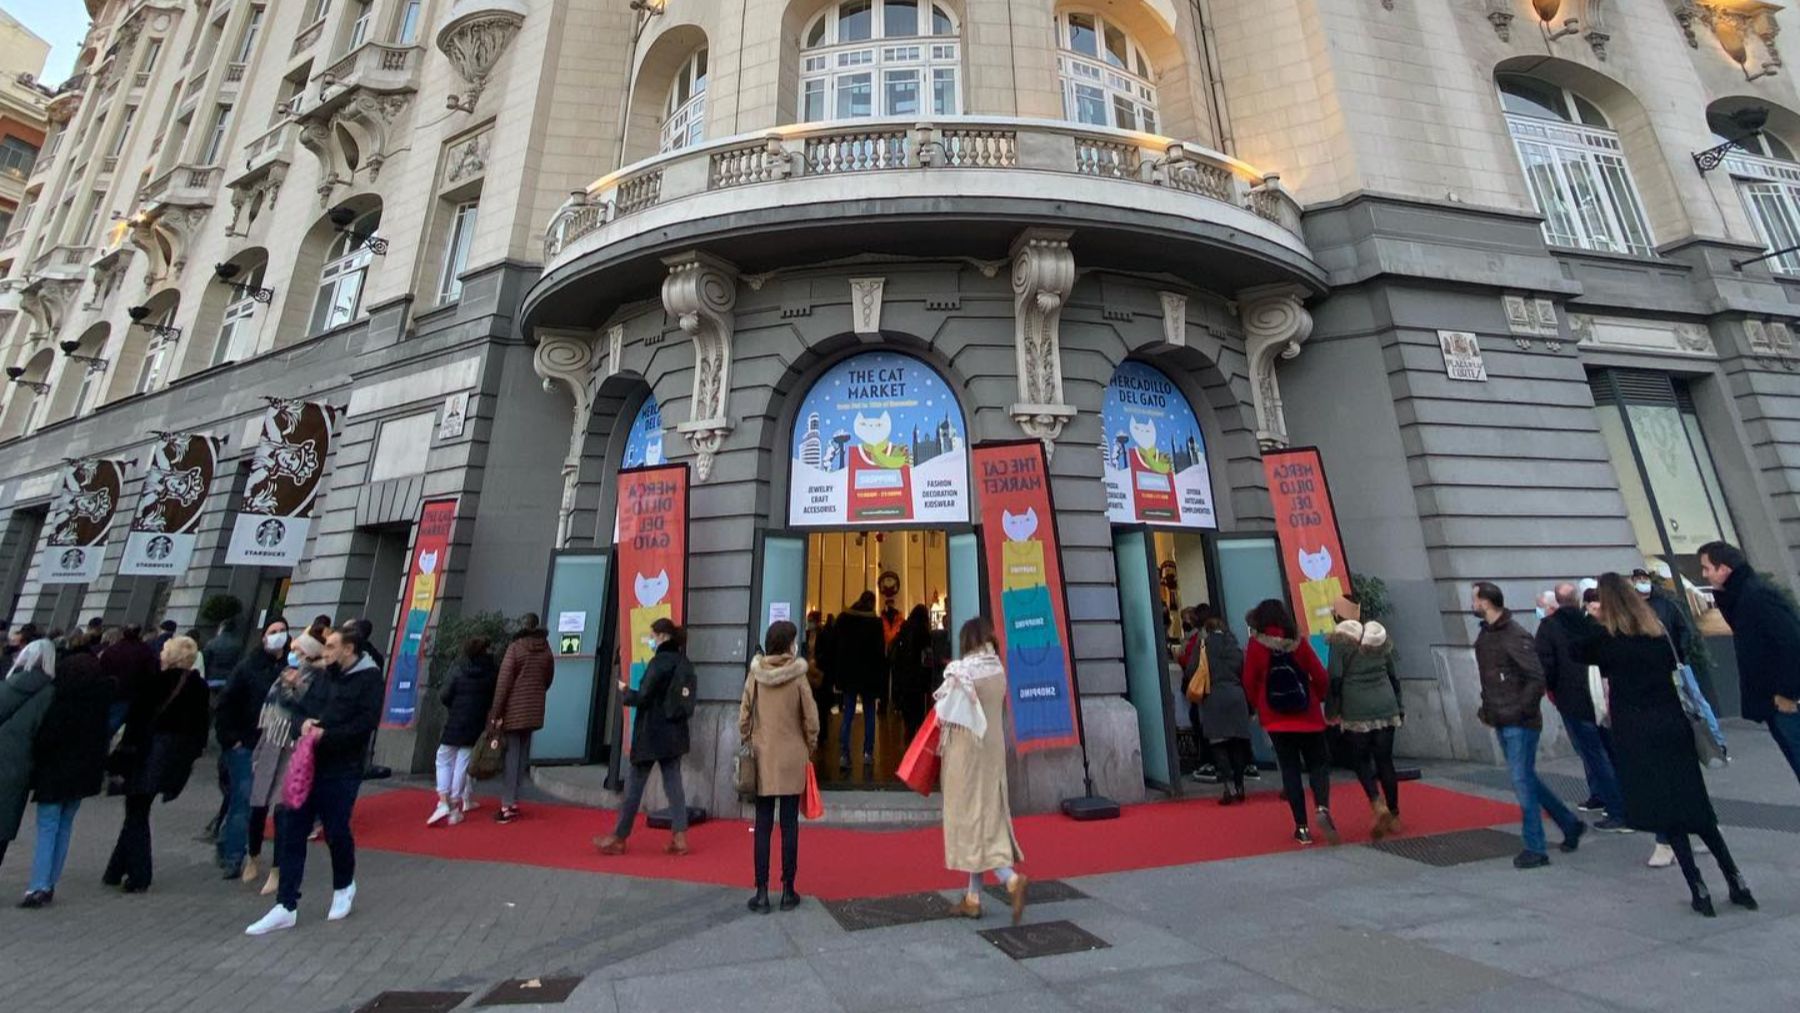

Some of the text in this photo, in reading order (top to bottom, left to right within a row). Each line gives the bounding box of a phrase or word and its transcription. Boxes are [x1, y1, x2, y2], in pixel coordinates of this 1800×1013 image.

[848, 368, 905, 384] THE CAT
[1110, 375, 1172, 395] MERCADILLO
[848, 383, 906, 400] MARKET
[1119, 390, 1166, 408] DEL GATO
[926, 480, 952, 488] FASHION
[808, 485, 833, 494] JEWELRY
[922, 490, 957, 498] DECORATION
[810, 495, 829, 503] CRAFT
[925, 499, 955, 508] KIDSWEAR
